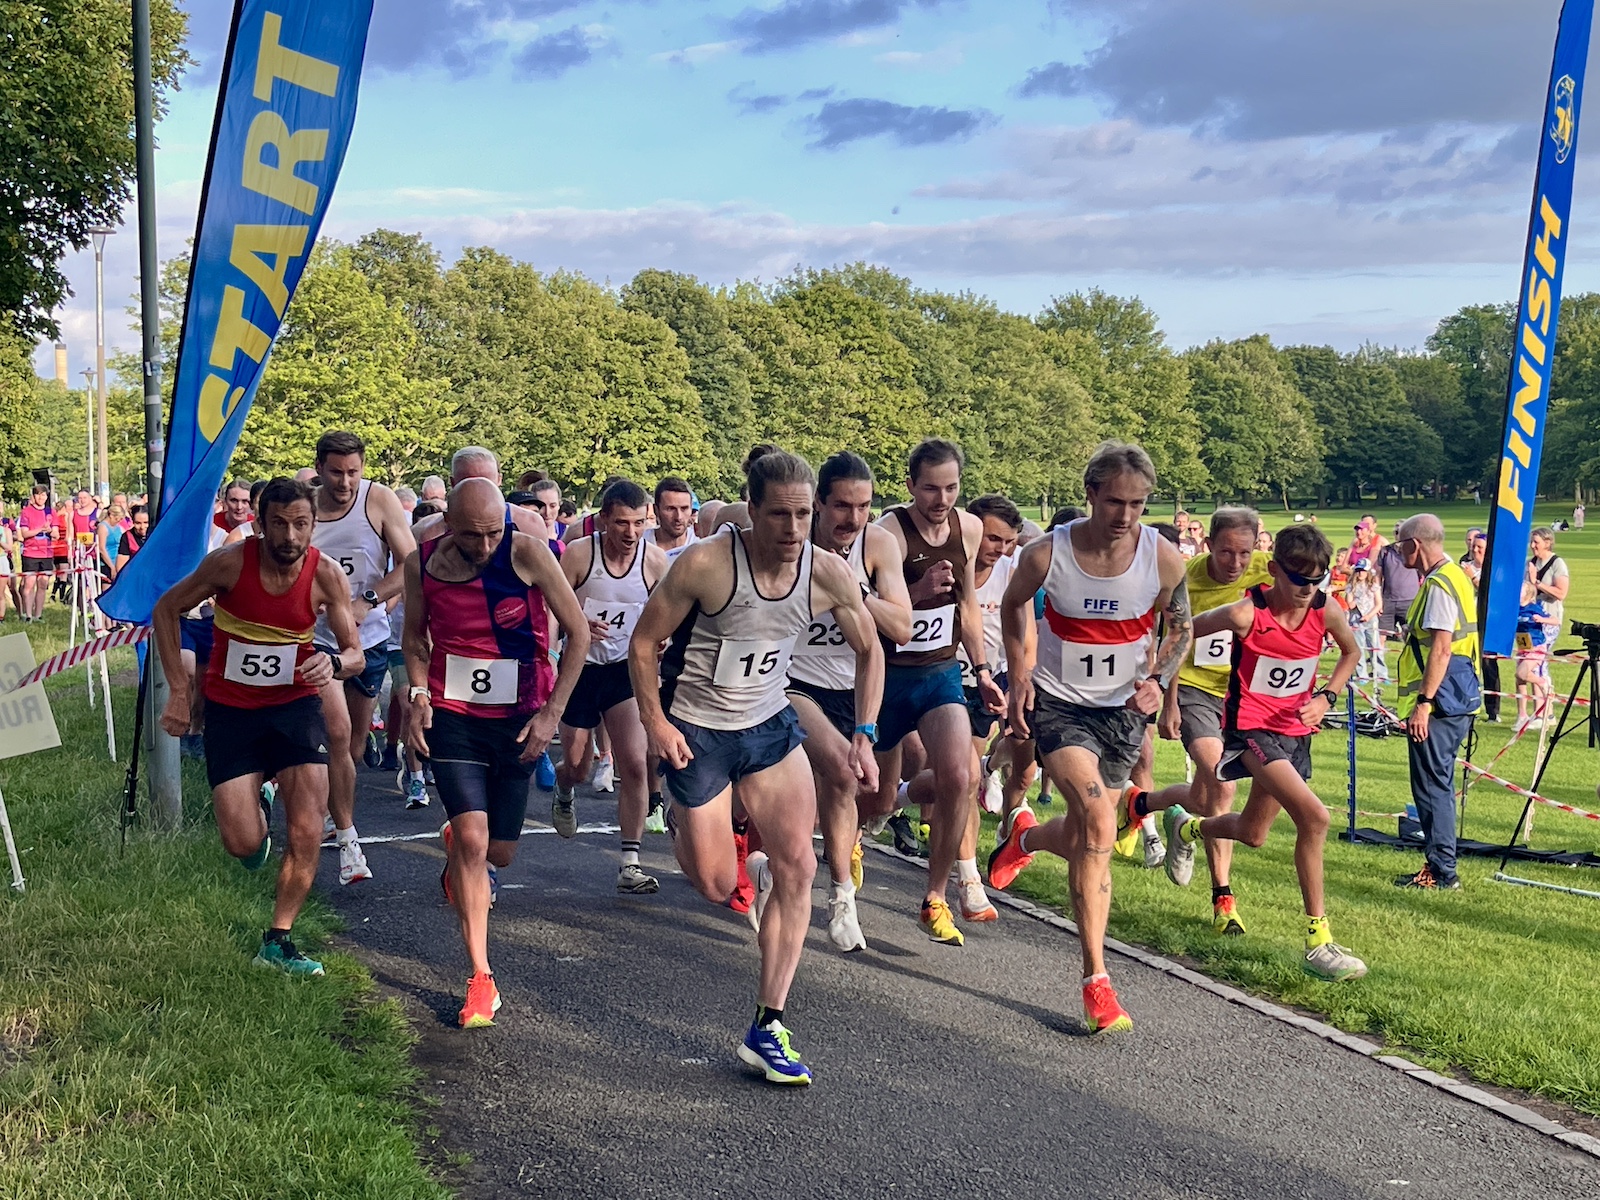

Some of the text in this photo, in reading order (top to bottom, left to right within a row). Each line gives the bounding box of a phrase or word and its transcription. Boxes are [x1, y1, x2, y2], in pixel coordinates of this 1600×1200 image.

[1497, 194, 1562, 523] FINISH
[331, 556, 355, 576] 5
[1083, 598, 1119, 611] FIFE
[807, 622, 847, 646] 23
[910, 617, 944, 643] 22
[1207, 638, 1232, 658] 5
[240, 653, 282, 678] 53
[739, 649, 781, 677] 15
[1079, 653, 1115, 678] 11
[470, 668, 492, 694] 8
[1267, 667, 1304, 689] 92
